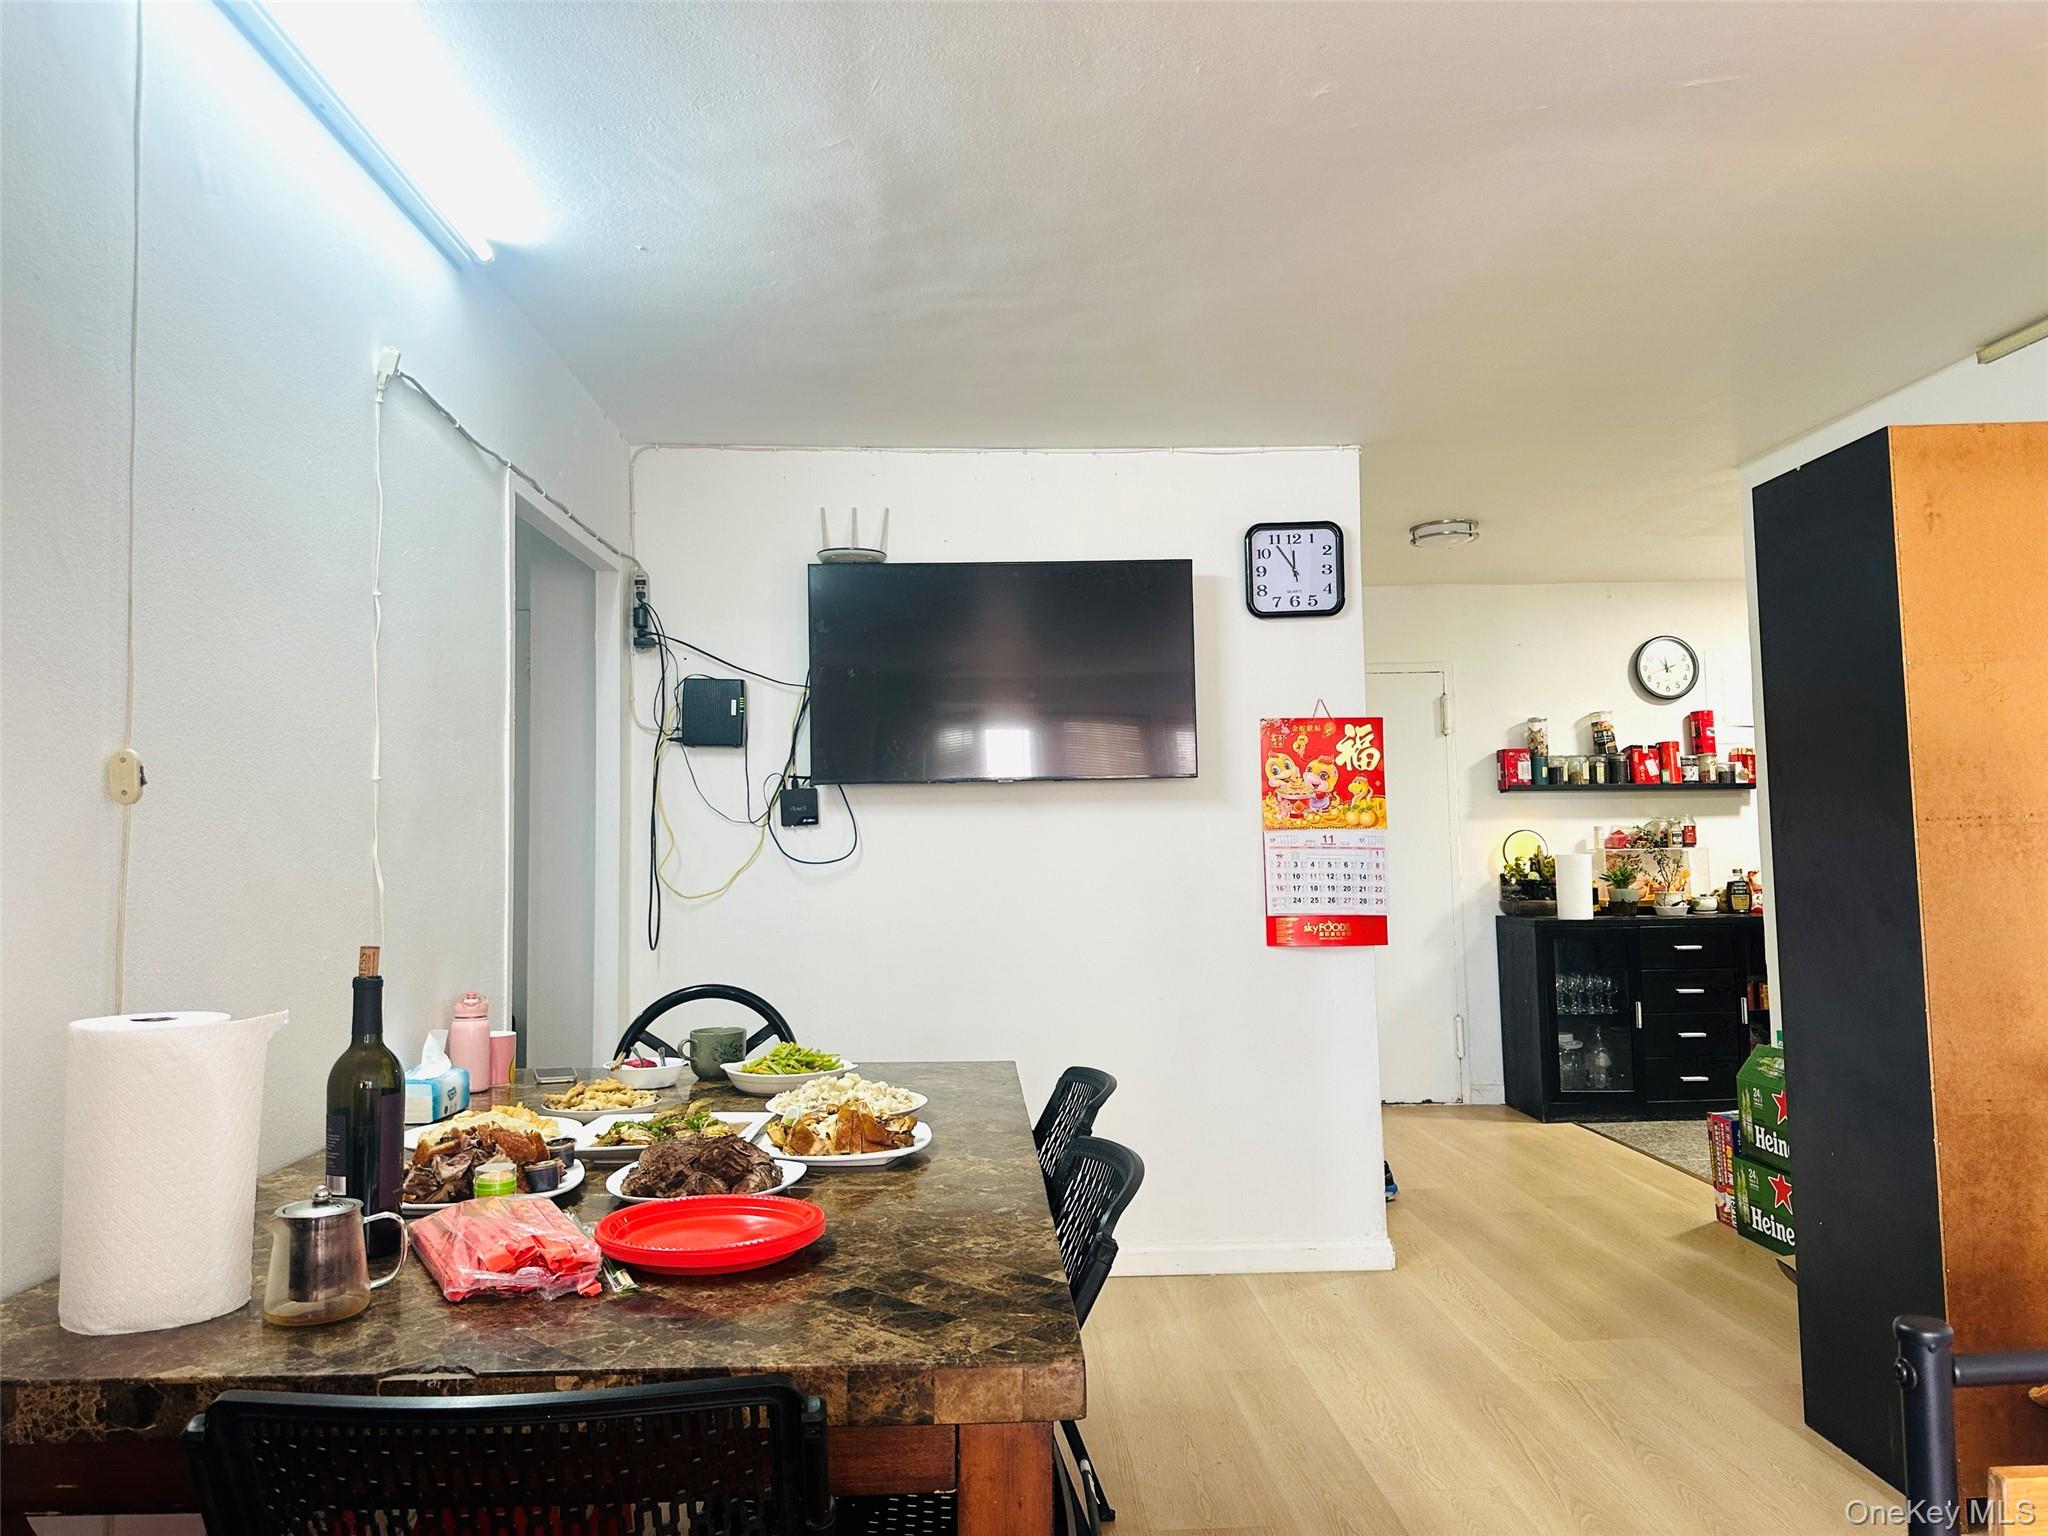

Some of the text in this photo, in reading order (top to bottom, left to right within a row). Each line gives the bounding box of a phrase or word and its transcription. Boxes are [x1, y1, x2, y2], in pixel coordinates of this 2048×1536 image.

[1269, 534, 1280, 544] 11
[1286, 533, 1302, 545] 12
[1309, 533, 1314, 544] 1
[1257, 548, 1271, 559] 10
[1322, 544, 1332, 556] 2
[1256, 565, 1267, 577] 9
[1321, 563, 1333, 575] 3
[1256, 584, 1268, 597] 8
[1323, 583, 1333, 594] 4
[1272, 596, 1282, 608] 7
[1289, 595, 1300, 608] 6
[1307, 594, 1318, 607] 5
[1335, 723, 1381, 771] 福
[1322, 834, 1334, 843] 11
[1753, 1087, 1760, 1098] 24
[1754, 1125, 1790, 1158] Hein
[1748, 1168, 1756, 1179] 24
[1750, 1206, 1796, 1246] Heine
